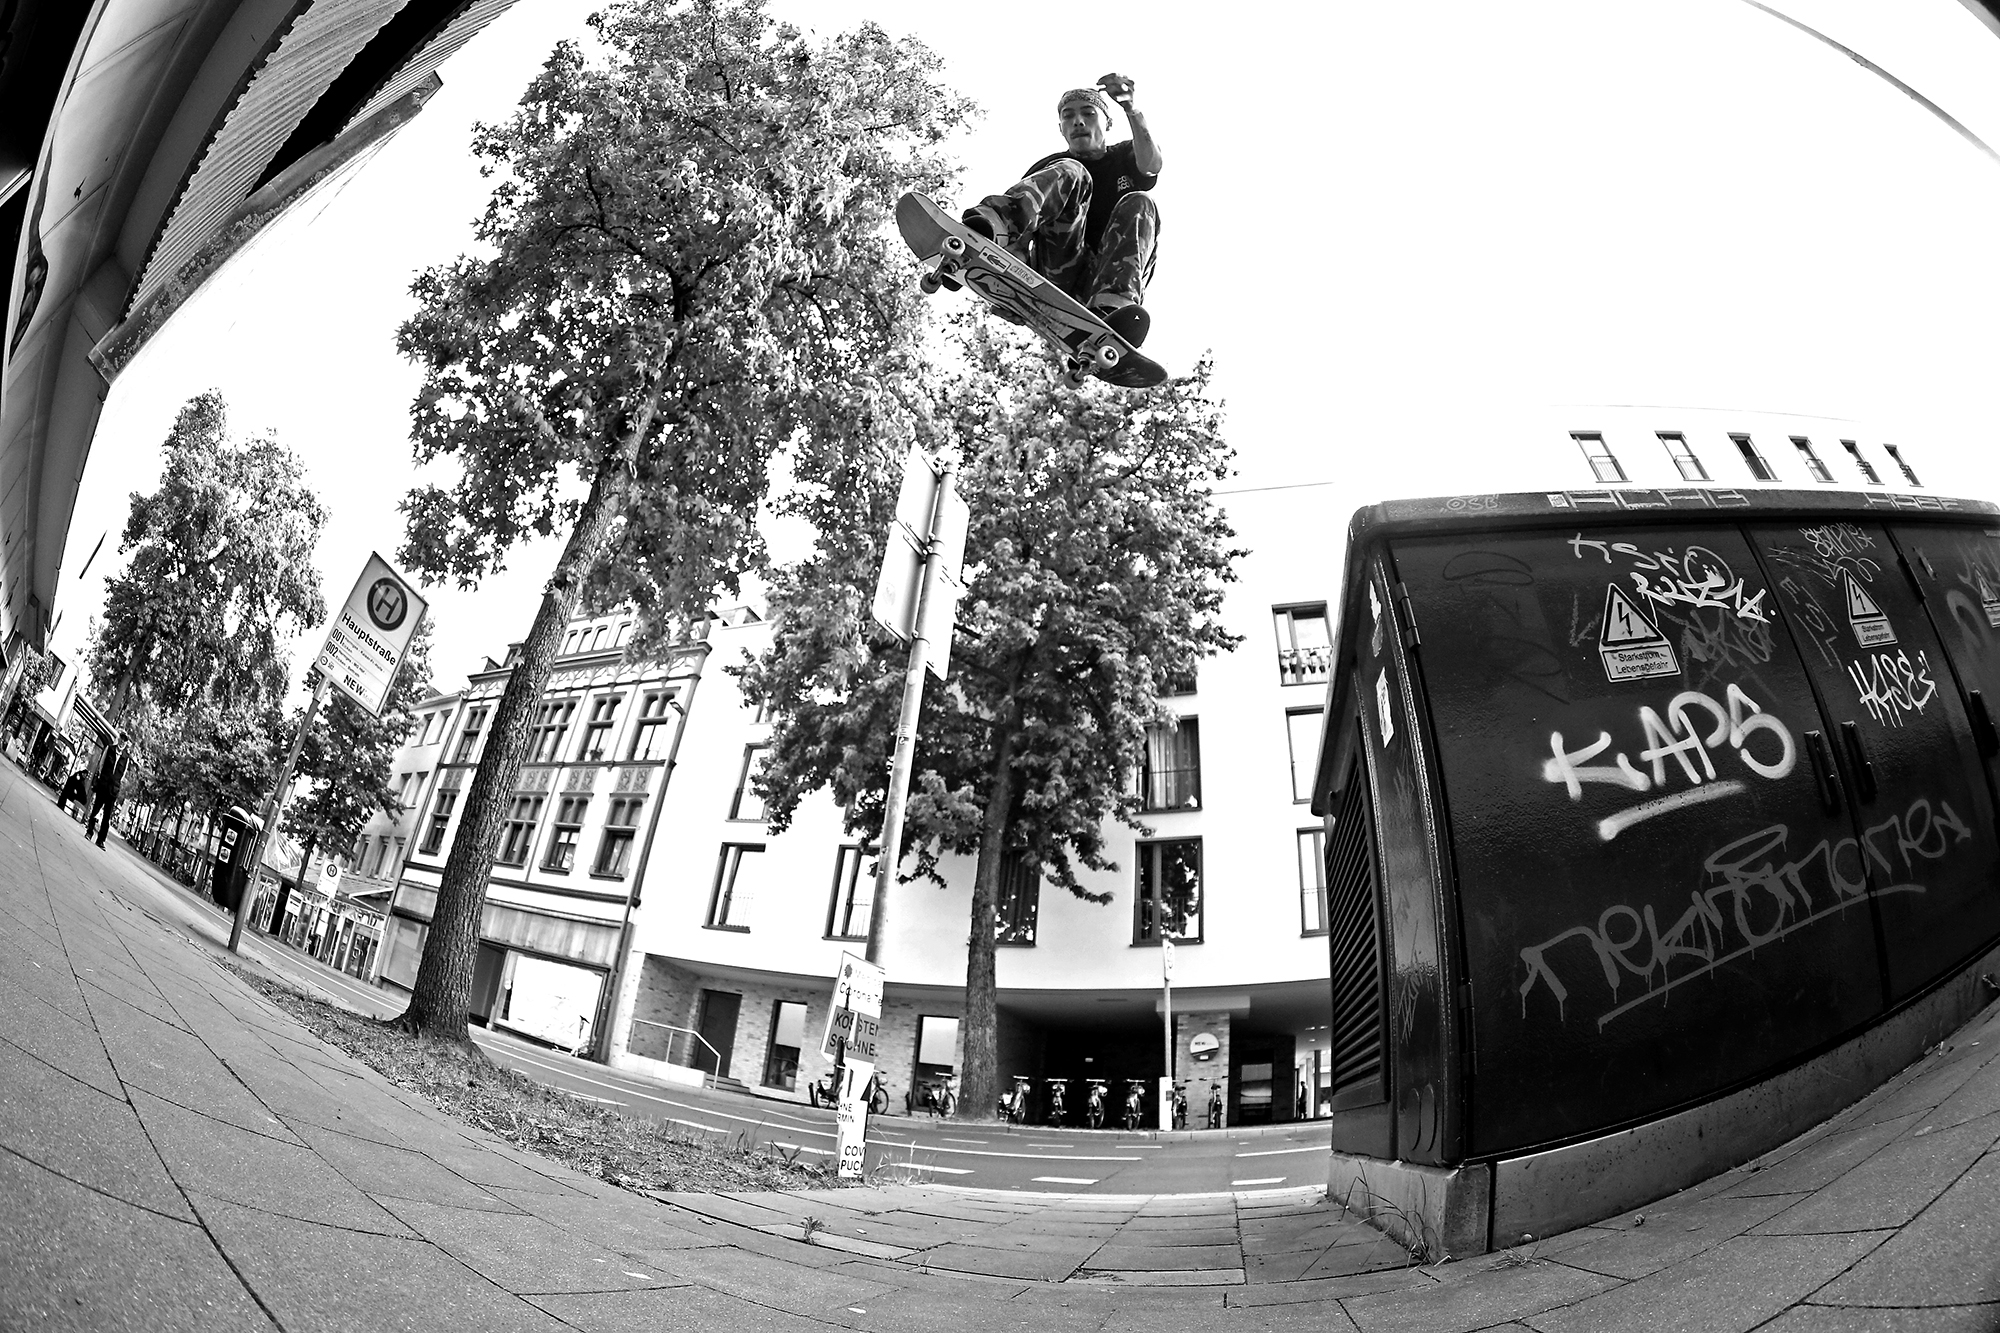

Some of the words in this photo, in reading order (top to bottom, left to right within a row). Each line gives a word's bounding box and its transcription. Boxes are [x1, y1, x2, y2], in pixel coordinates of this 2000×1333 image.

[375, 586, 400, 622] H
[331, 628, 345, 645] 001
[341, 612, 396, 665] Hauptstraße
[325, 641, 339, 657] 002
[343, 674, 365, 696] NEW
